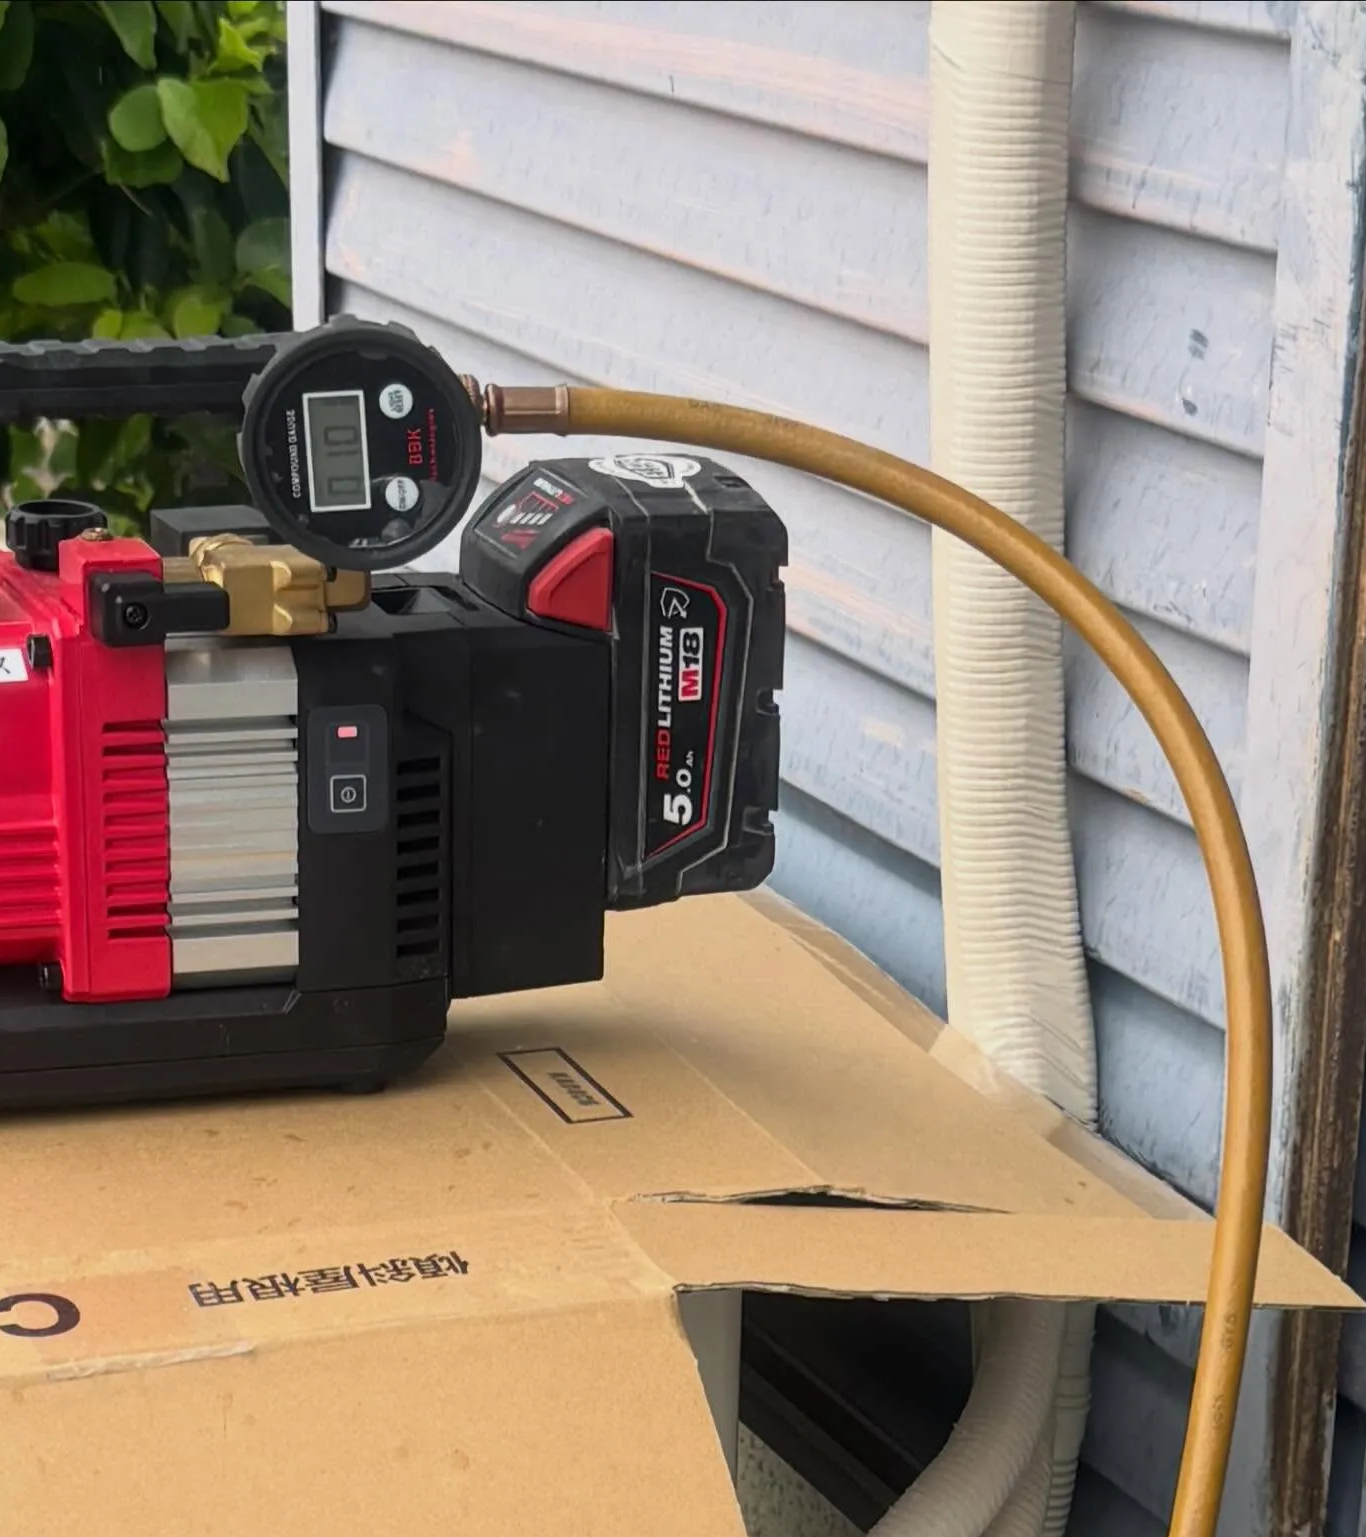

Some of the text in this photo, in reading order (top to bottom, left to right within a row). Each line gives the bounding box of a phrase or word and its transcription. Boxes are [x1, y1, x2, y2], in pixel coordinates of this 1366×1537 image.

[286, 409, 301, 498] COMPOUND GAUGE
[681, 631, 702, 699] M18
[656, 625, 673, 781] REDLITHIUM
[662, 768, 692, 826] 5.0
[190, 1248, 471, 1308] 傾斜屋根用
